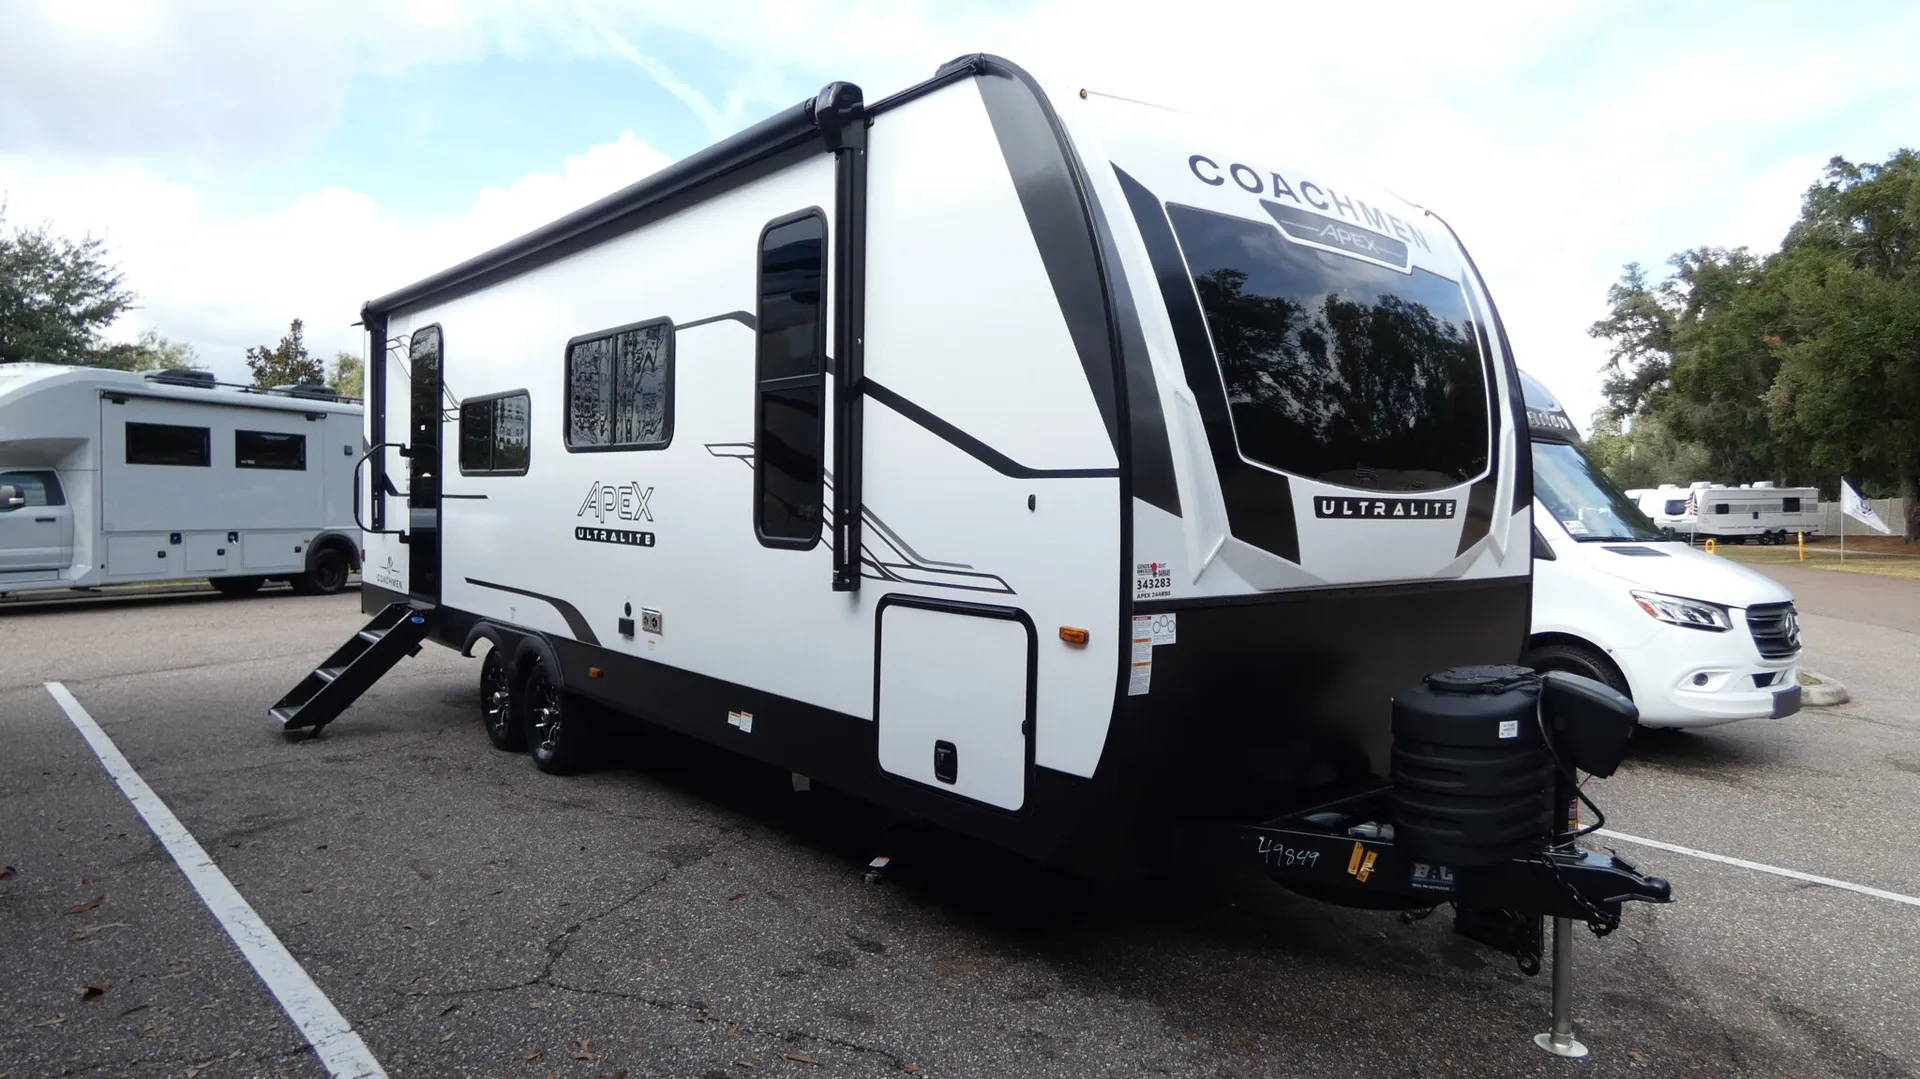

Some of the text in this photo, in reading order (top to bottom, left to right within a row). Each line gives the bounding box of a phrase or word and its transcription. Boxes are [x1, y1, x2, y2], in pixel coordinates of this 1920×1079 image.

[1188, 154, 1432, 254] COACHMEN
[1319, 223, 1380, 254] APEX
[577, 480, 655, 524] APEX
[1322, 500, 1453, 516] ULTRALITE
[577, 528, 652, 545] ULTRALITE
[376, 573, 403, 589] COACHMEN
[1136, 577, 1171, 590] 343283
[1258, 836, 1320, 867] 49849
